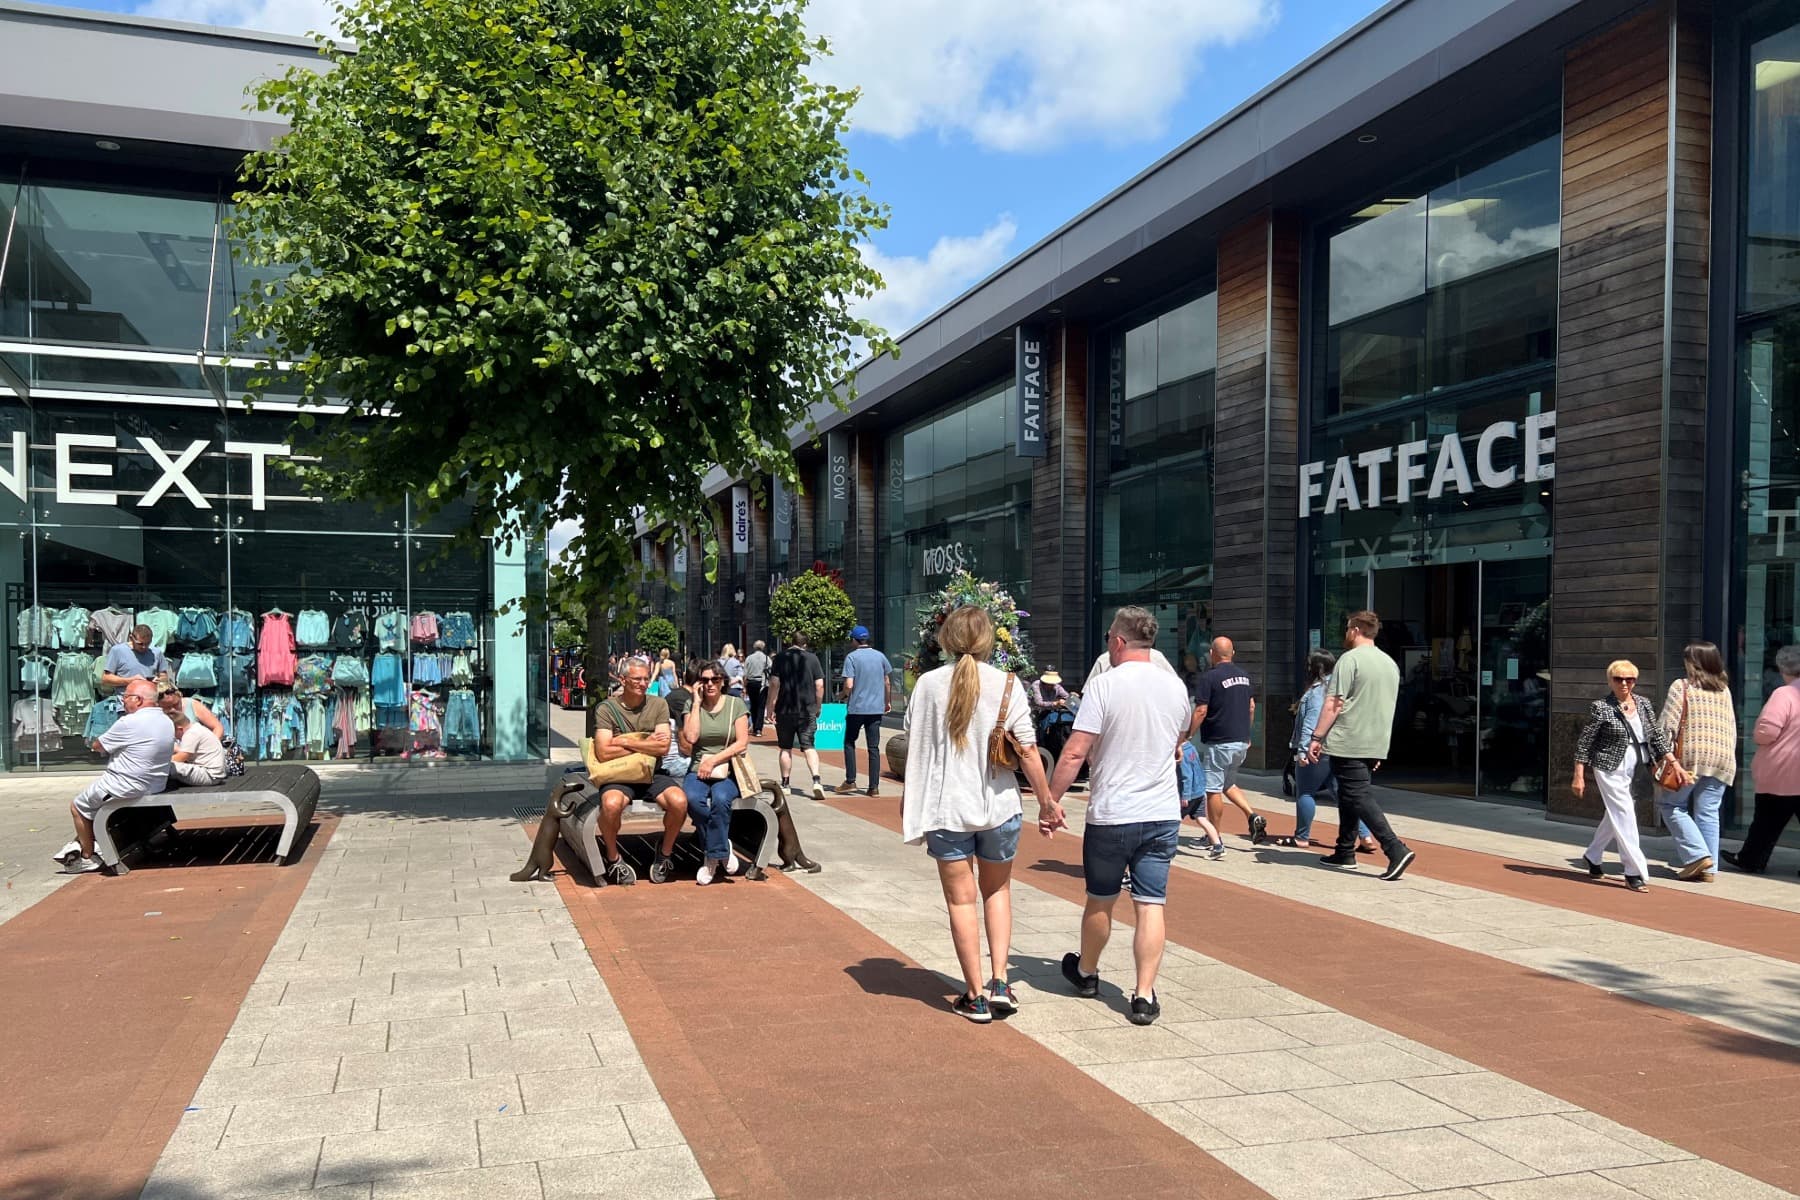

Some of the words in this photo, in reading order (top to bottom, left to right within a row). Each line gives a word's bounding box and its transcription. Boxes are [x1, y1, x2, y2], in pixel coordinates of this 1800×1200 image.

[1024, 340, 1040, 442] FATFACE
[833, 455, 845, 500] MOSS
[1299, 410, 1557, 518] FATFACE
[735, 500, 746, 542] claire's
[923, 541, 962, 577] MOSS
[816, 720, 843, 734] iteley
